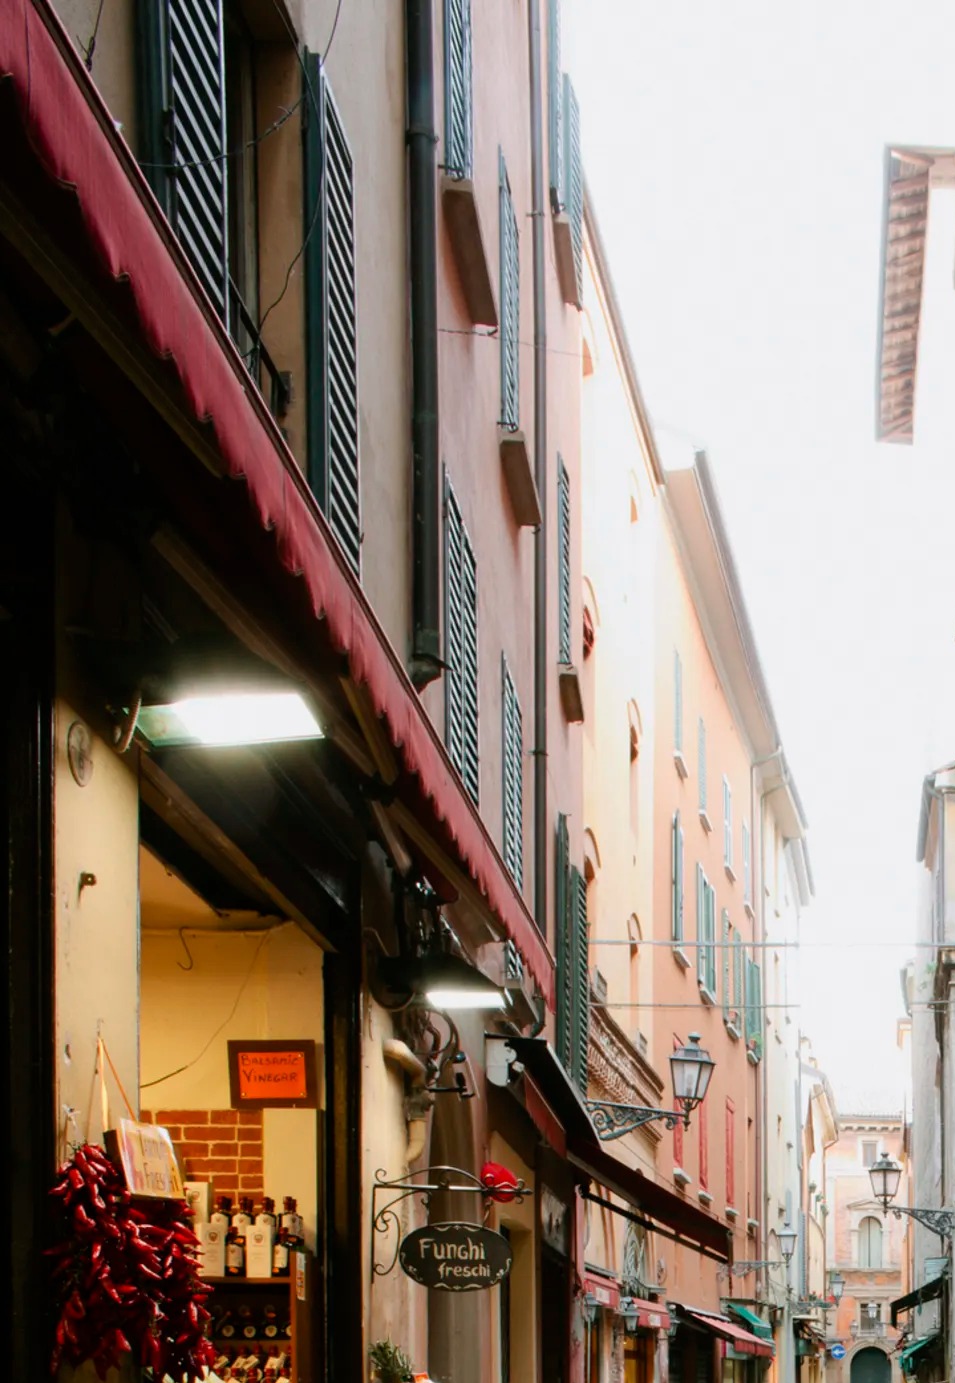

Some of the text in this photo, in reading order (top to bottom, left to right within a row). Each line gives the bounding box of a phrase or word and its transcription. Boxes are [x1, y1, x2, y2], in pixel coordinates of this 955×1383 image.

[241, 1054, 299, 1066] BALSAMIC
[242, 1068, 298, 1083] VINEGAR
[419, 1237, 486, 1260] Funghi
[438, 1262, 491, 1279] freschi
